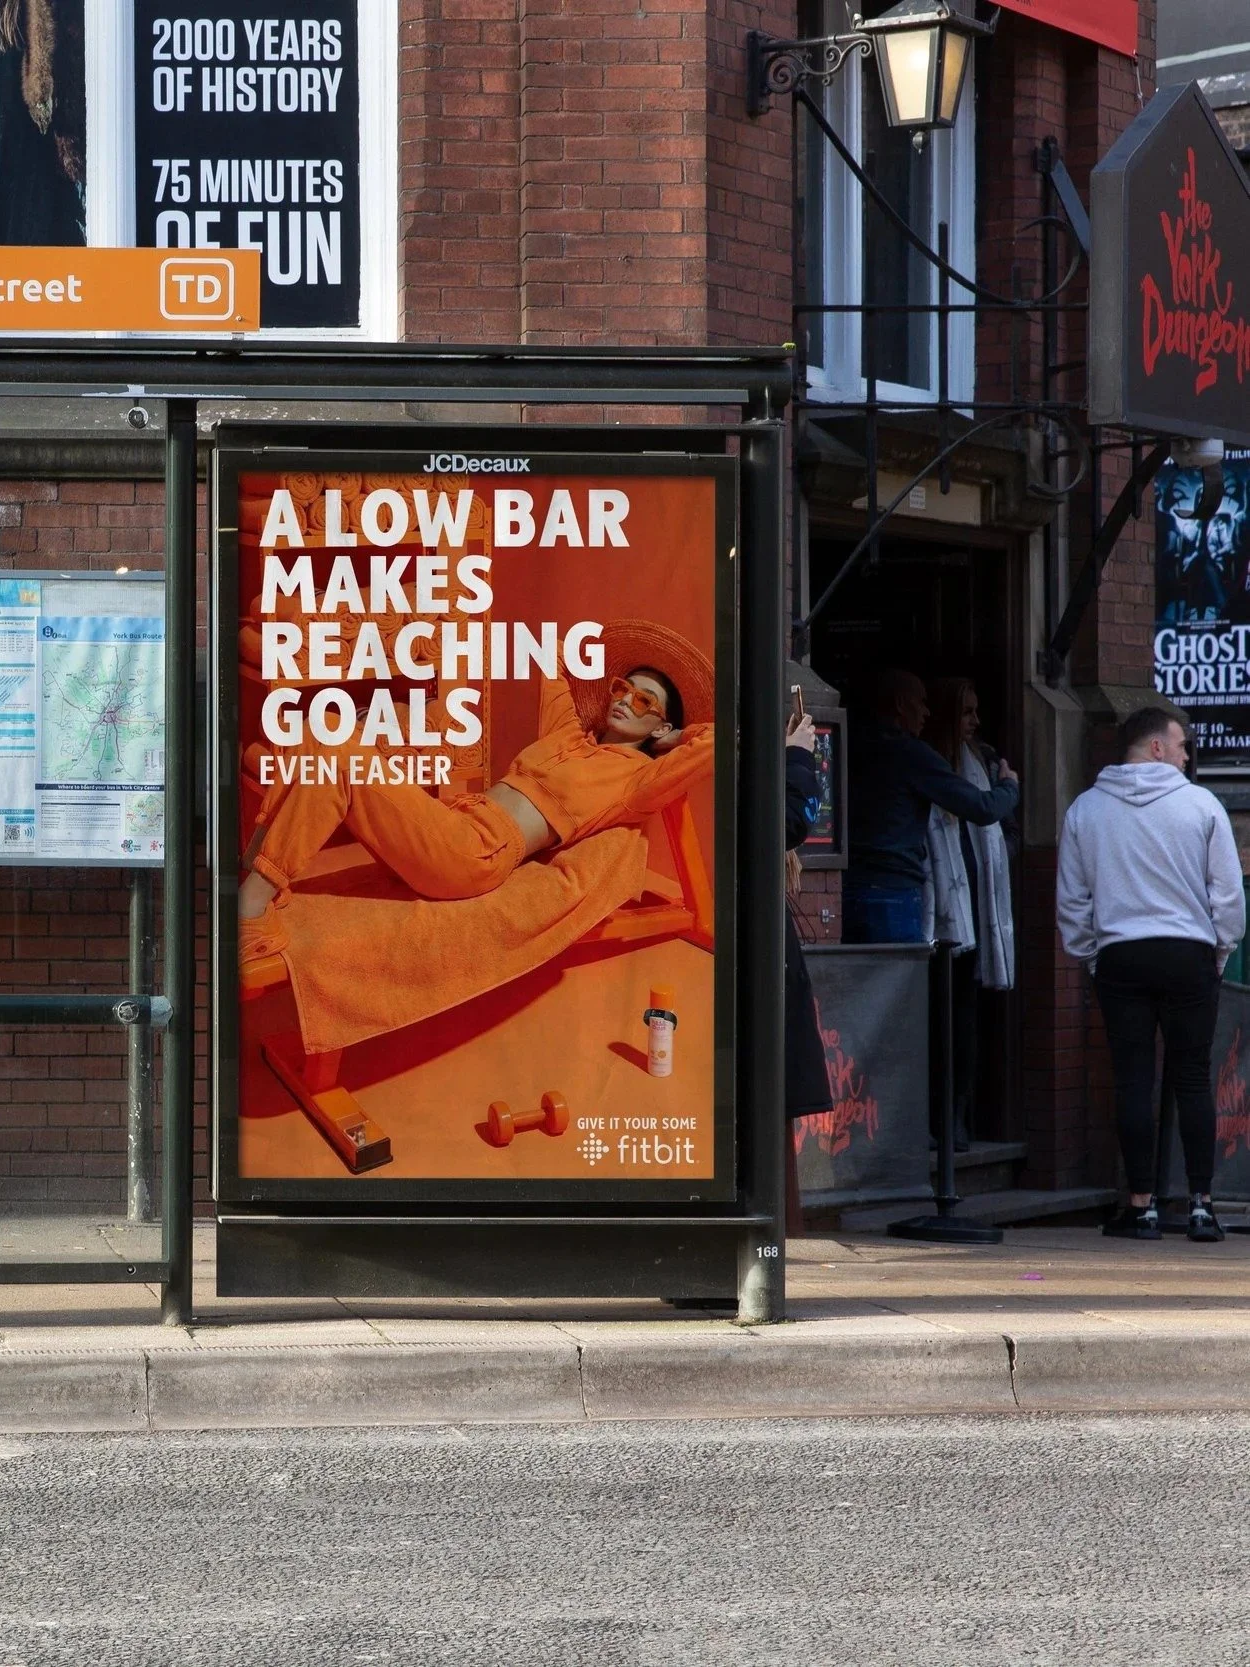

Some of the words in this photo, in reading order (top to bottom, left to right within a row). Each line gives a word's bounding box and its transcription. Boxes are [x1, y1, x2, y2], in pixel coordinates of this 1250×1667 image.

[153, 19, 235, 61] 2000
[243, 20, 342, 61] YEARS
[153, 67, 193, 112] OF
[202, 68, 343, 112] HISTORY
[152, 160, 190, 203] 75
[200, 160, 343, 203] MINUTES
[1179, 147, 1213, 237] the
[238, 211, 341, 285] FUN
[1160, 212, 1233, 315] York
[171, 274, 222, 303] TD
[423, 454, 531, 473] JCDecaux
[259, 489, 305, 548] A
[325, 488, 475, 548] LOW
[494, 489, 630, 548] BAR
[260, 555, 494, 614] MAKES
[261, 621, 605, 681] REACHING
[1154, 626, 1250, 665] GHOST
[1154, 660, 1250, 695] TORIE
[261, 687, 483, 747] GOALS
[1211, 723, 1225, 734] 10
[1210, 736, 1222, 748] 14
[260, 755, 337, 785] EVEN
[349, 755, 451, 785] EASIER
[577, 1117, 605, 1130] GIVE
[609, 1117, 620, 1130] IT
[624, 1117, 658, 1130] YOUR
[662, 1117, 697, 1130] SOME
[617, 1134, 695, 1165] fitbit
[756, 1246, 779, 1258] 168
